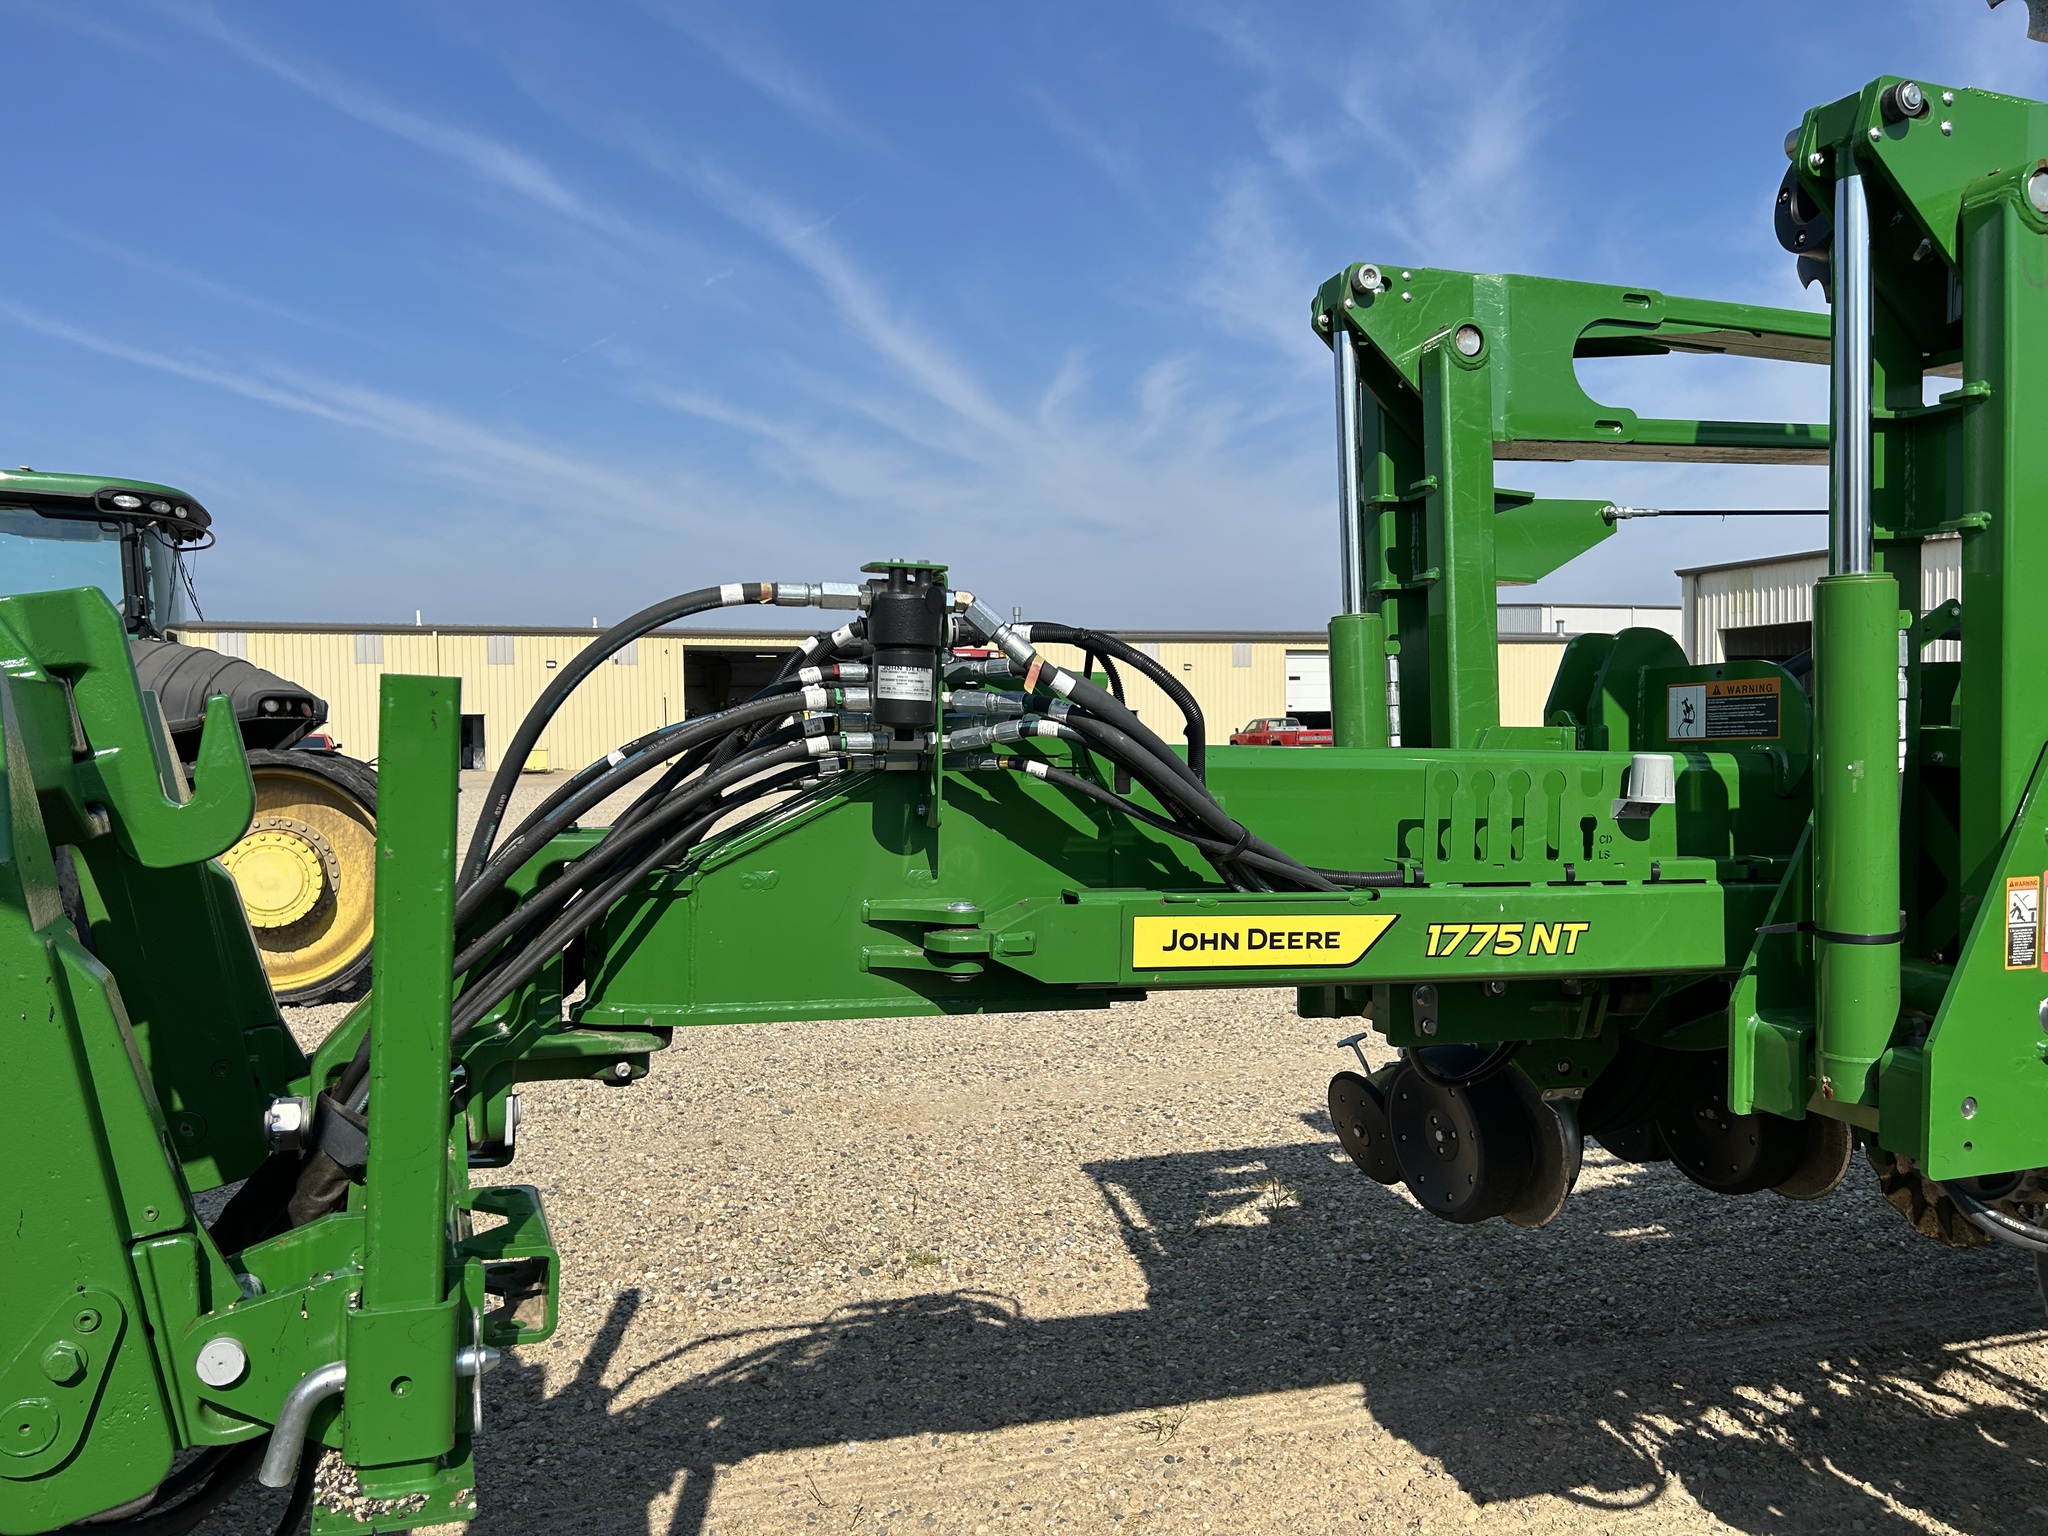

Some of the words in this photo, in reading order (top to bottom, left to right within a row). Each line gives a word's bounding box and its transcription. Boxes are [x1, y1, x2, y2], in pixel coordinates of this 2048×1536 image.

[1727, 683, 1773, 694] WARNING
[1598, 834, 1613, 845] CD
[1598, 850, 1611, 860] LS
[1162, 928, 1240, 952] JOHN
[1247, 929, 1341, 951] DEERE
[2003, 1217, 2026, 1231] GATES
